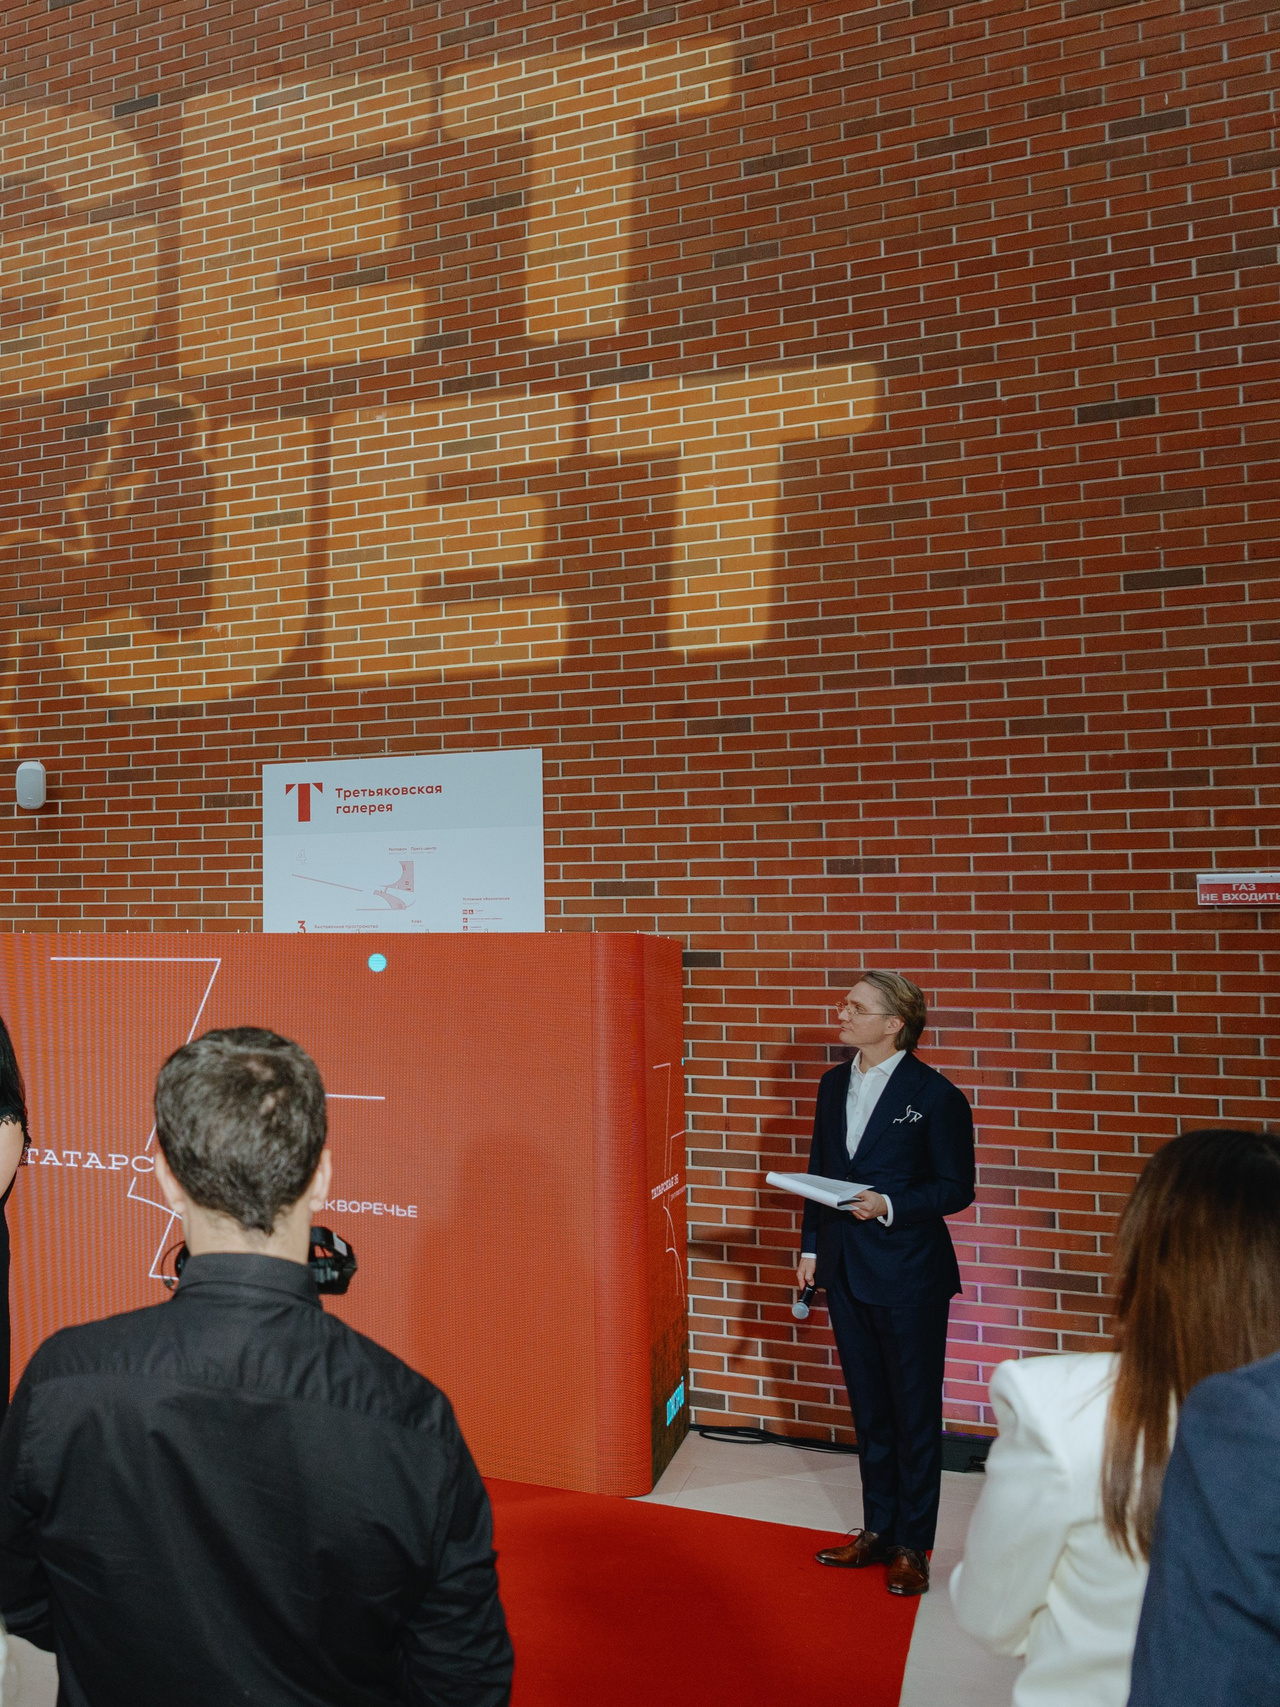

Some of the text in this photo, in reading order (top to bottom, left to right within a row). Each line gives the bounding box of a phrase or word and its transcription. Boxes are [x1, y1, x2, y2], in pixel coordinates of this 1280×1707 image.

[335, 785, 442, 800] Третьяковская
[336, 803, 393, 815] галерея
[1232, 883, 1256, 891] ГАЗ
[1201, 893, 1218, 901] НЕ
[26, 1147, 155, 1173] ТАТАРС
[322, 1199, 418, 1218] КВОРЕЧЬЕ
